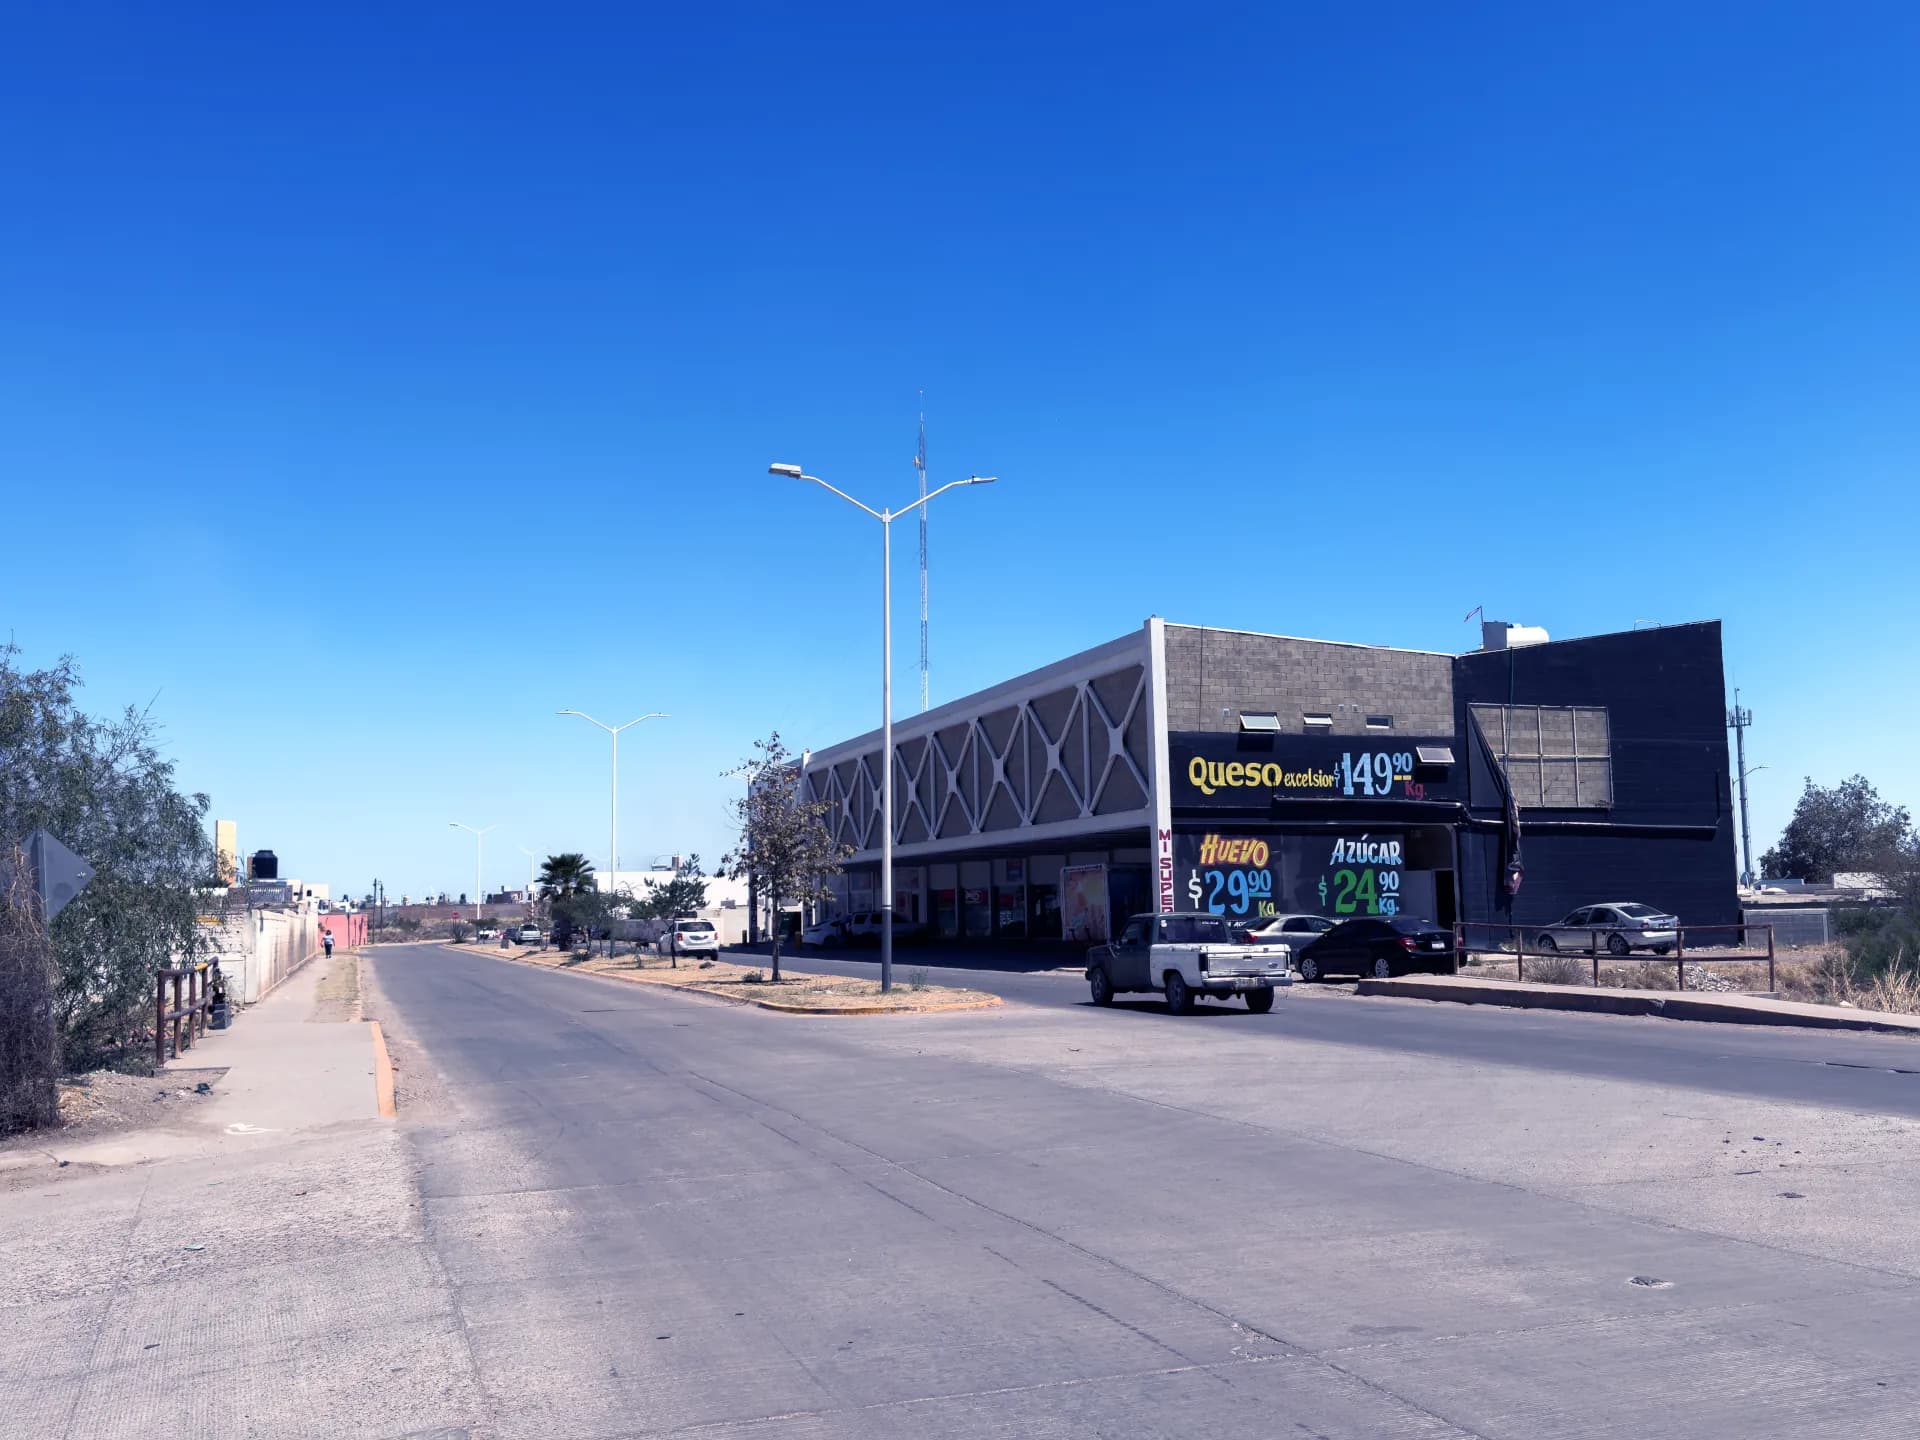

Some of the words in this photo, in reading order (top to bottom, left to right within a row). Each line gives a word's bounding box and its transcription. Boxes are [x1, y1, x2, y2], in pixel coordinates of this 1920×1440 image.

[1188, 756, 1283, 795] Queso
[1284, 768, 1334, 788] excelsior
[1159, 829, 1171, 852] MI
[1200, 834, 1270, 868] HUEVO
[1329, 833, 1403, 866] AZÚCAR
